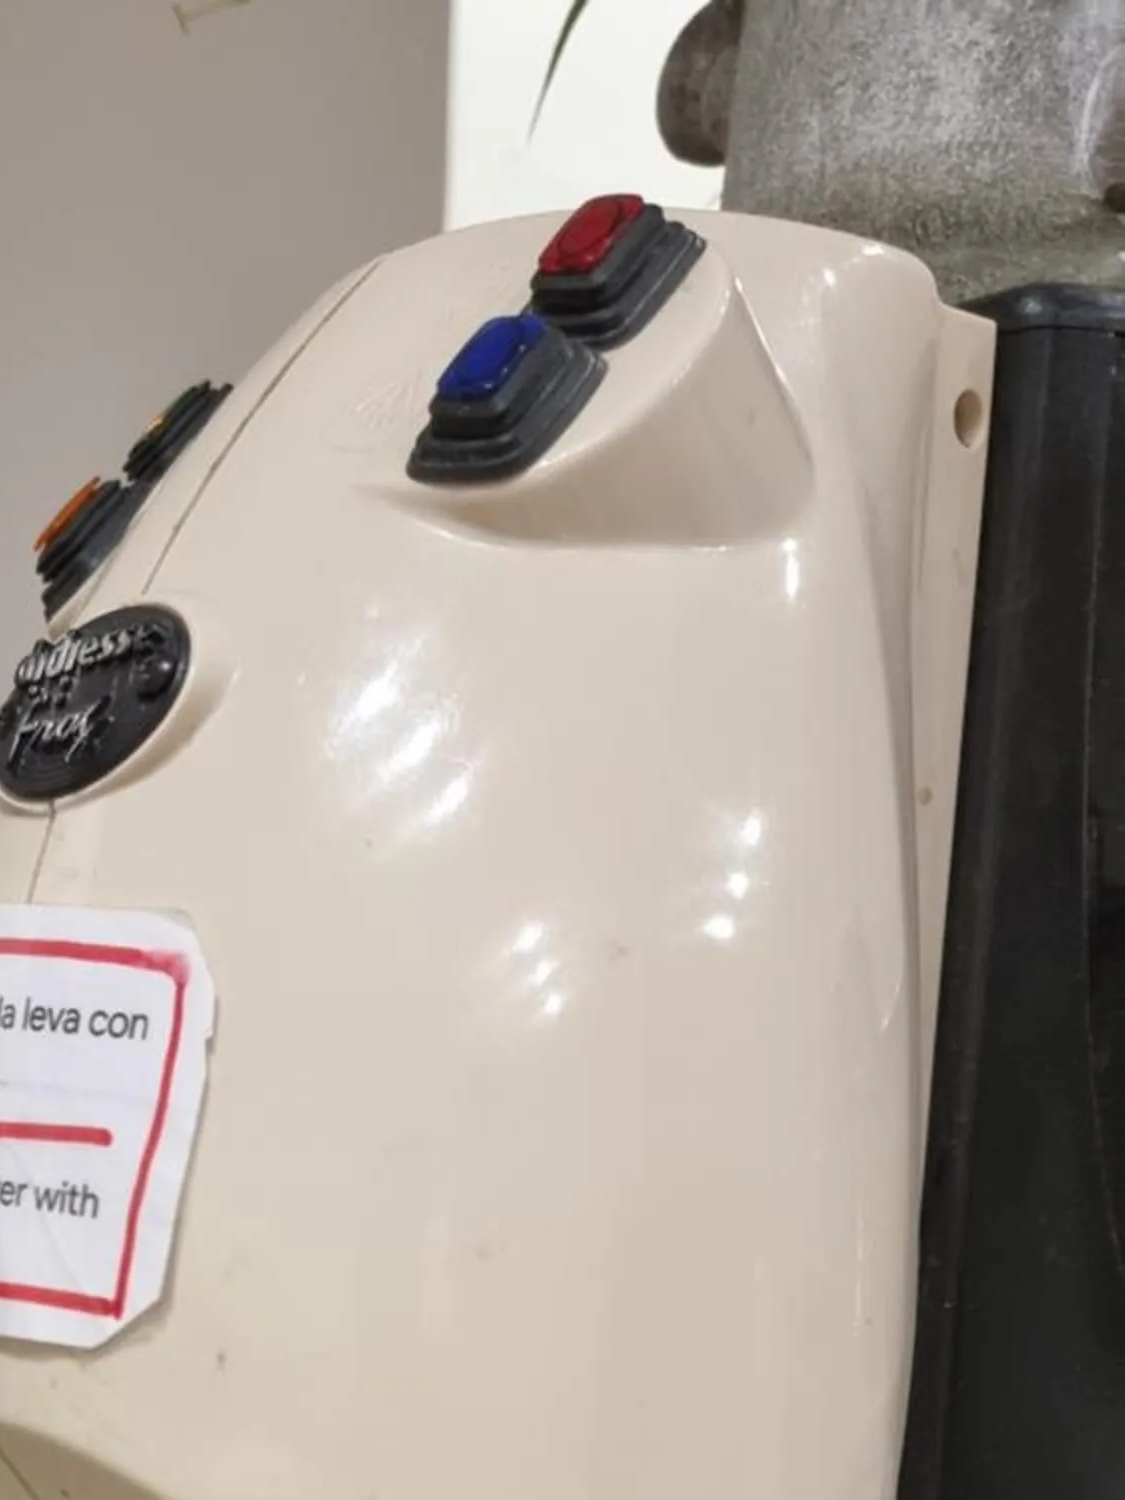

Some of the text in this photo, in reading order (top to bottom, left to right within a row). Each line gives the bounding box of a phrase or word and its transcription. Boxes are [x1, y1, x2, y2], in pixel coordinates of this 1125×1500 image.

[21, 995, 82, 1035] leva
[87, 1008, 149, 1041] con
[33, 1179, 100, 1220] with
